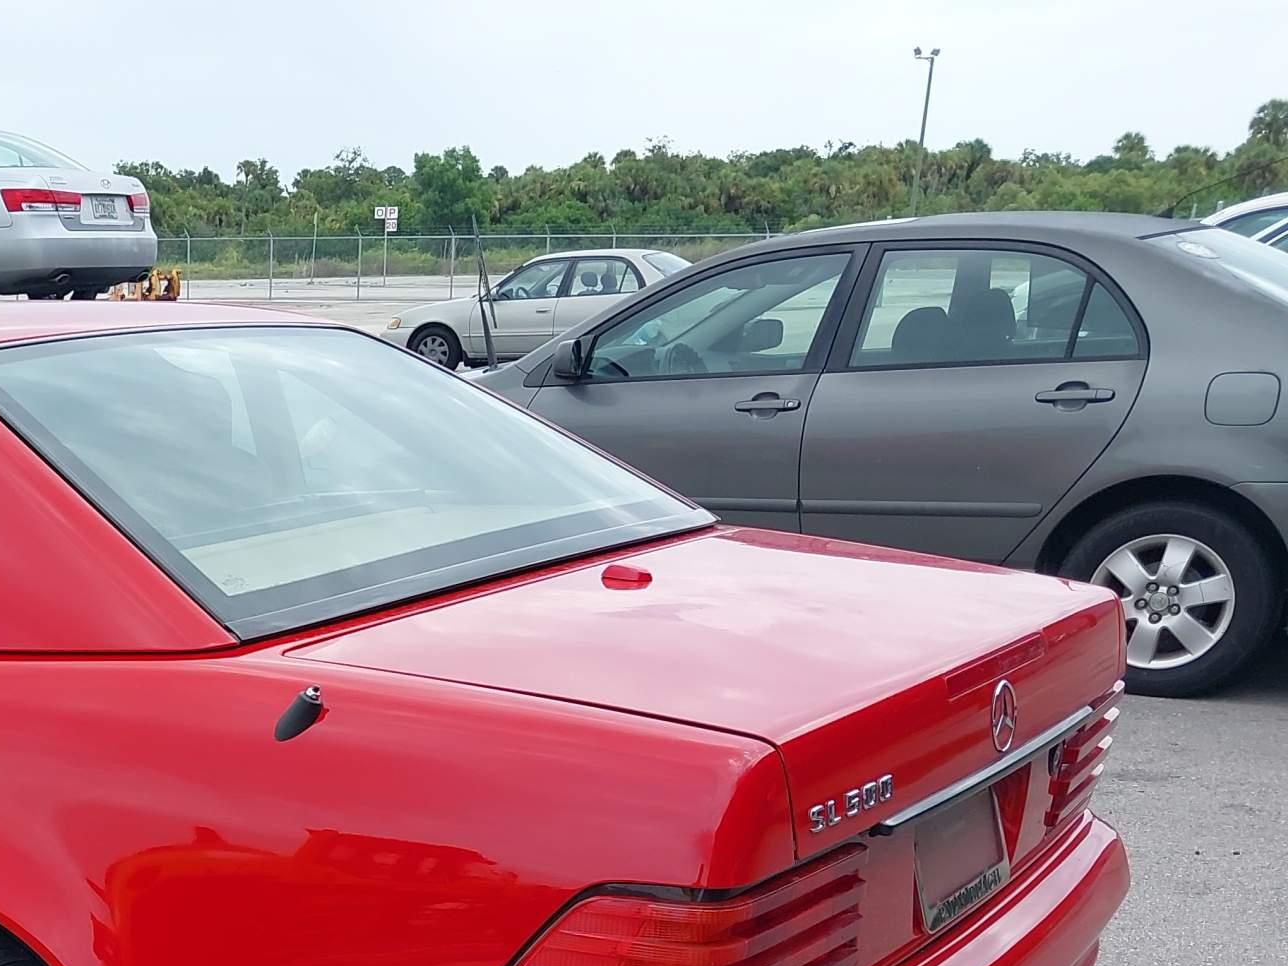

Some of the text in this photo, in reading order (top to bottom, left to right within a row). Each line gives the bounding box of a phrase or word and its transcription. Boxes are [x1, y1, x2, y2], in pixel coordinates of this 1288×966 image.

[389, 208, 396, 218] P
[386, 221, 397, 230] 20
[808, 773, 894, 833] SL 500
